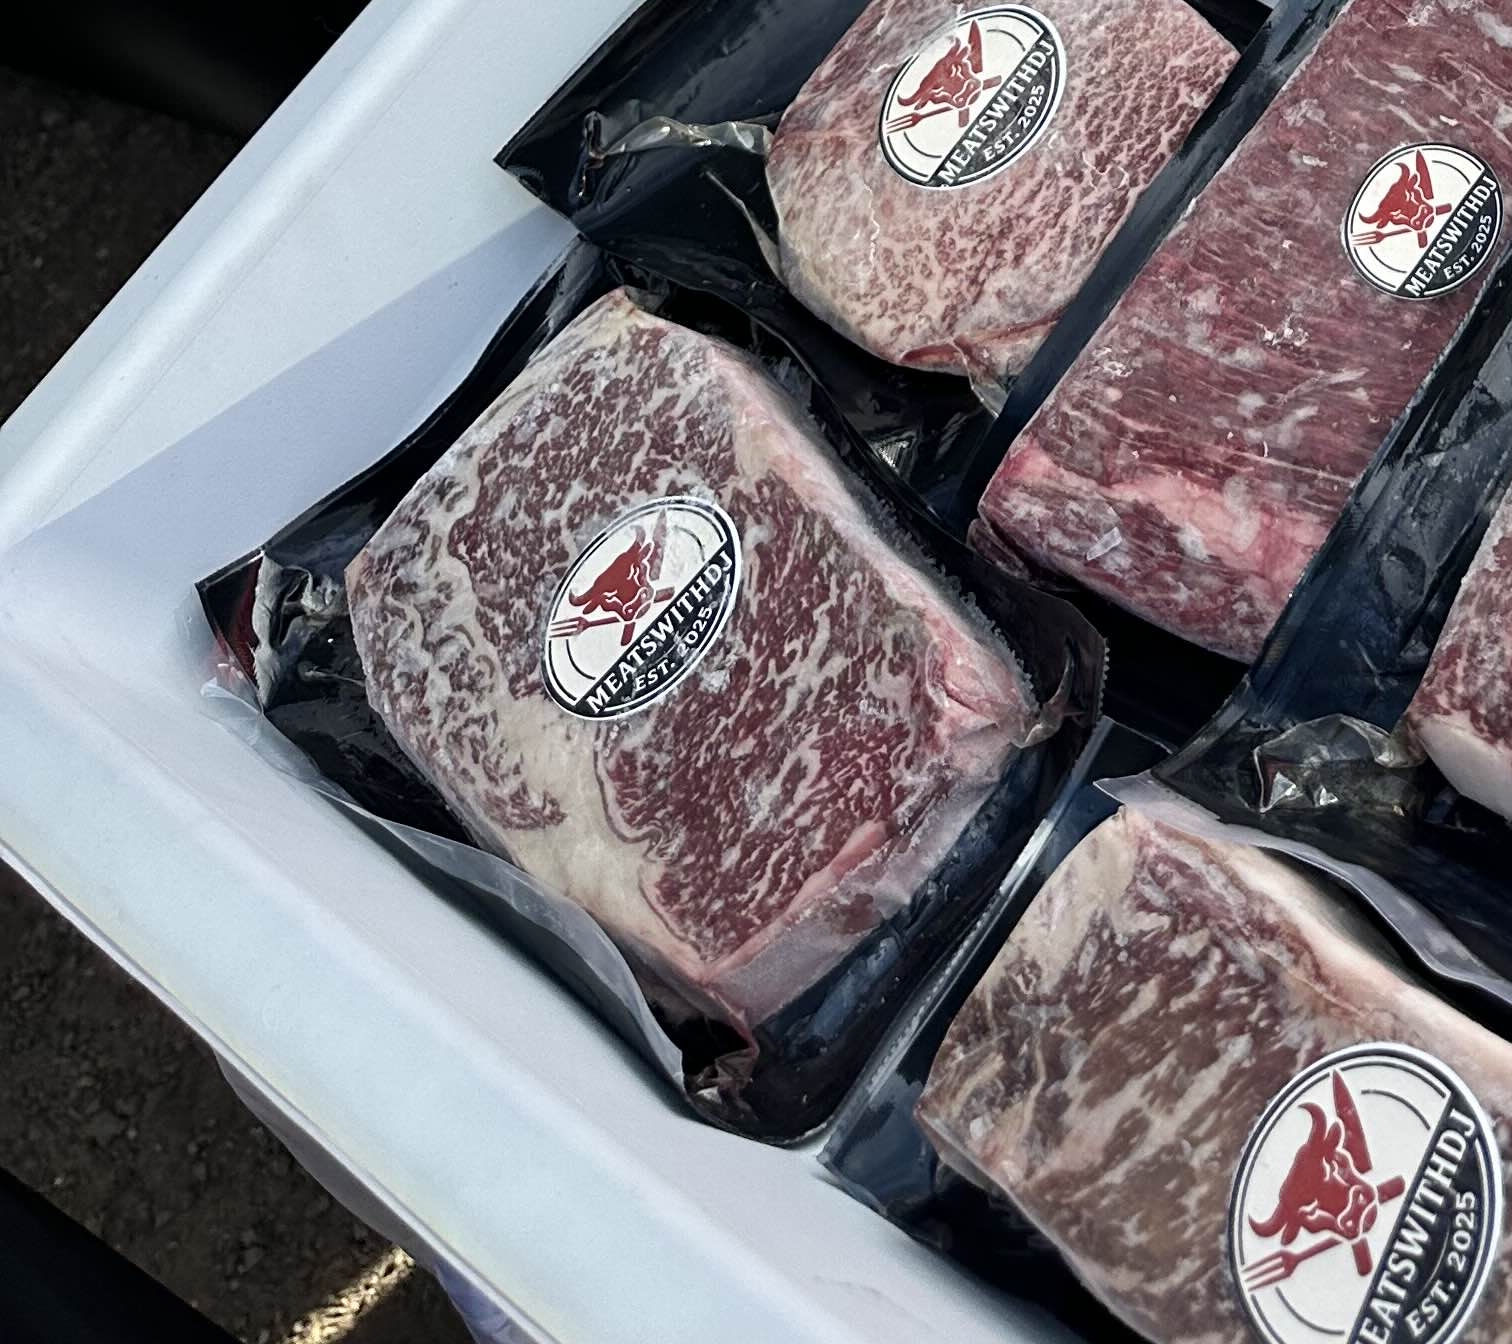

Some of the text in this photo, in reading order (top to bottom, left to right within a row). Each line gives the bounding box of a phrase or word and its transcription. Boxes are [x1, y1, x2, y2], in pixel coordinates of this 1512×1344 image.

[938, 40, 1055, 185] MEATSWITHDJ
[1018, 85, 1045, 129] 2025
[1404, 176, 1497, 297] MEATSWITHDJ
[1471, 215, 1492, 253] 2025
[586, 550, 733, 713] MEATSWITHDJ
[677, 607, 713, 657] 2025
[1356, 1108, 1476, 1344] EATSWITHDJ
[1447, 1191, 1476, 1273] 2025
